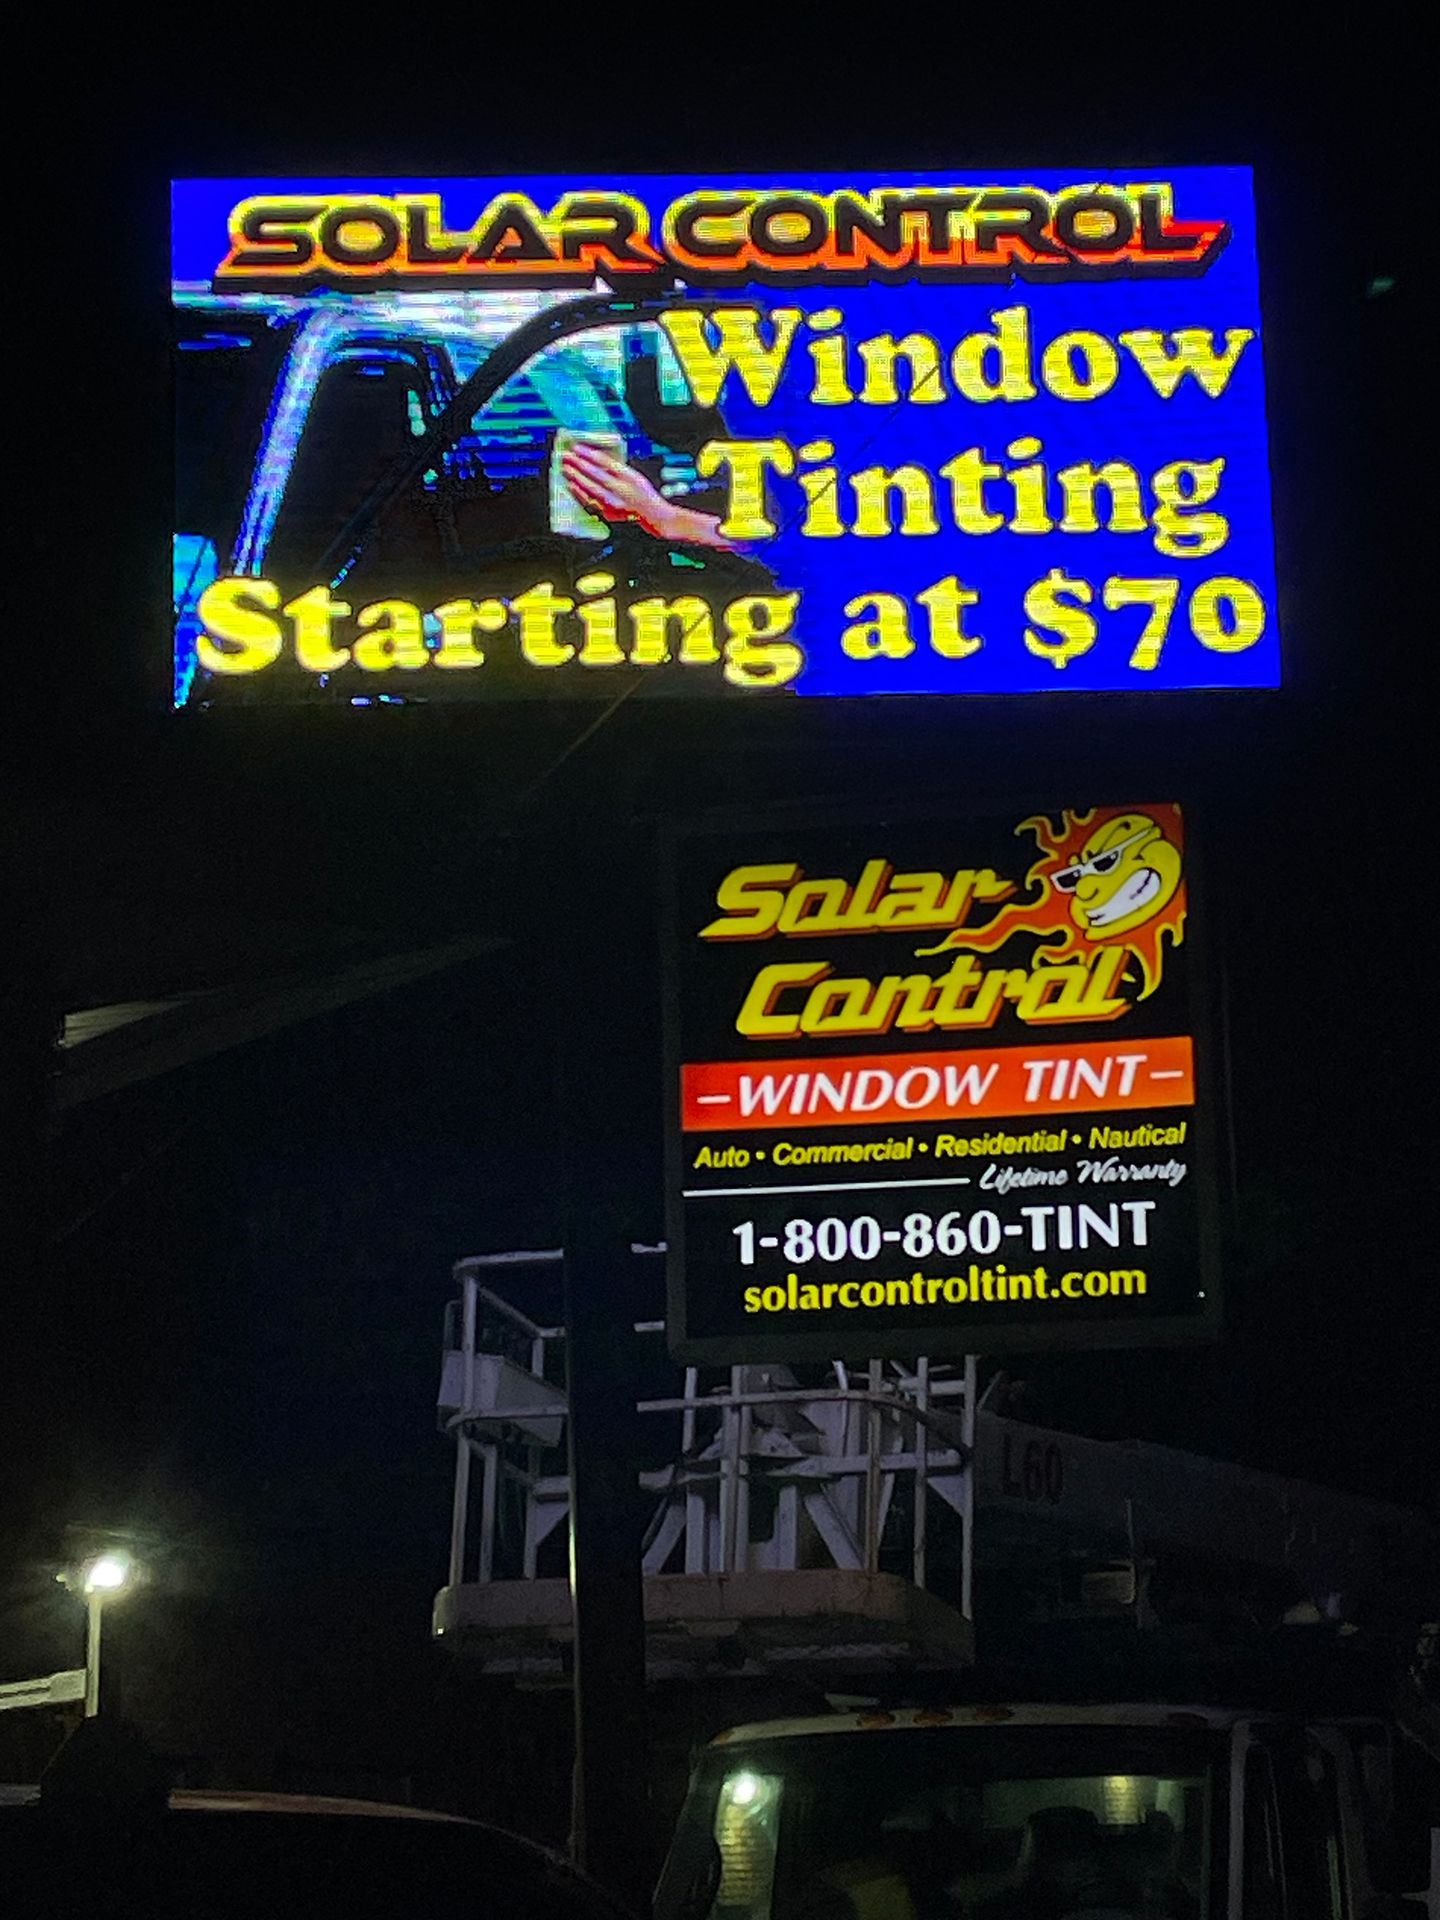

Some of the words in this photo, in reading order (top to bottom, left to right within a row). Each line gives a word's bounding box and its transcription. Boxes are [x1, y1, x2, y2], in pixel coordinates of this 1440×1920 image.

[218, 192, 664, 284] SOLAR
[660, 182, 1228, 282] CONTROL
[657, 304, 1255, 408] Window
[699, 436, 1230, 558] Tinting
[196, 572, 804, 688] Starting
[840, 573, 984, 660] at
[1022, 567, 1267, 671] $70
[698, 859, 1017, 942] Solar
[734, 946, 1132, 1041] Control
[737, 1064, 998, 1117] WINDOW
[1023, 1054, 1147, 1103] TINT
[692, 1145, 750, 1170] Auto
[771, 1136, 913, 1166] Commercial
[935, 1129, 1067, 1159] Residential
[1088, 1121, 1187, 1148] Nautical
[979, 1162, 1069, 1194] Lifetime
[1075, 1158, 1187, 1187] Warranty
[732, 1201, 1156, 1265] 1-800-860-TINT
[743, 1264, 1147, 1312] solarcontroltint.com
[1002, 1436, 1064, 1500] L60
